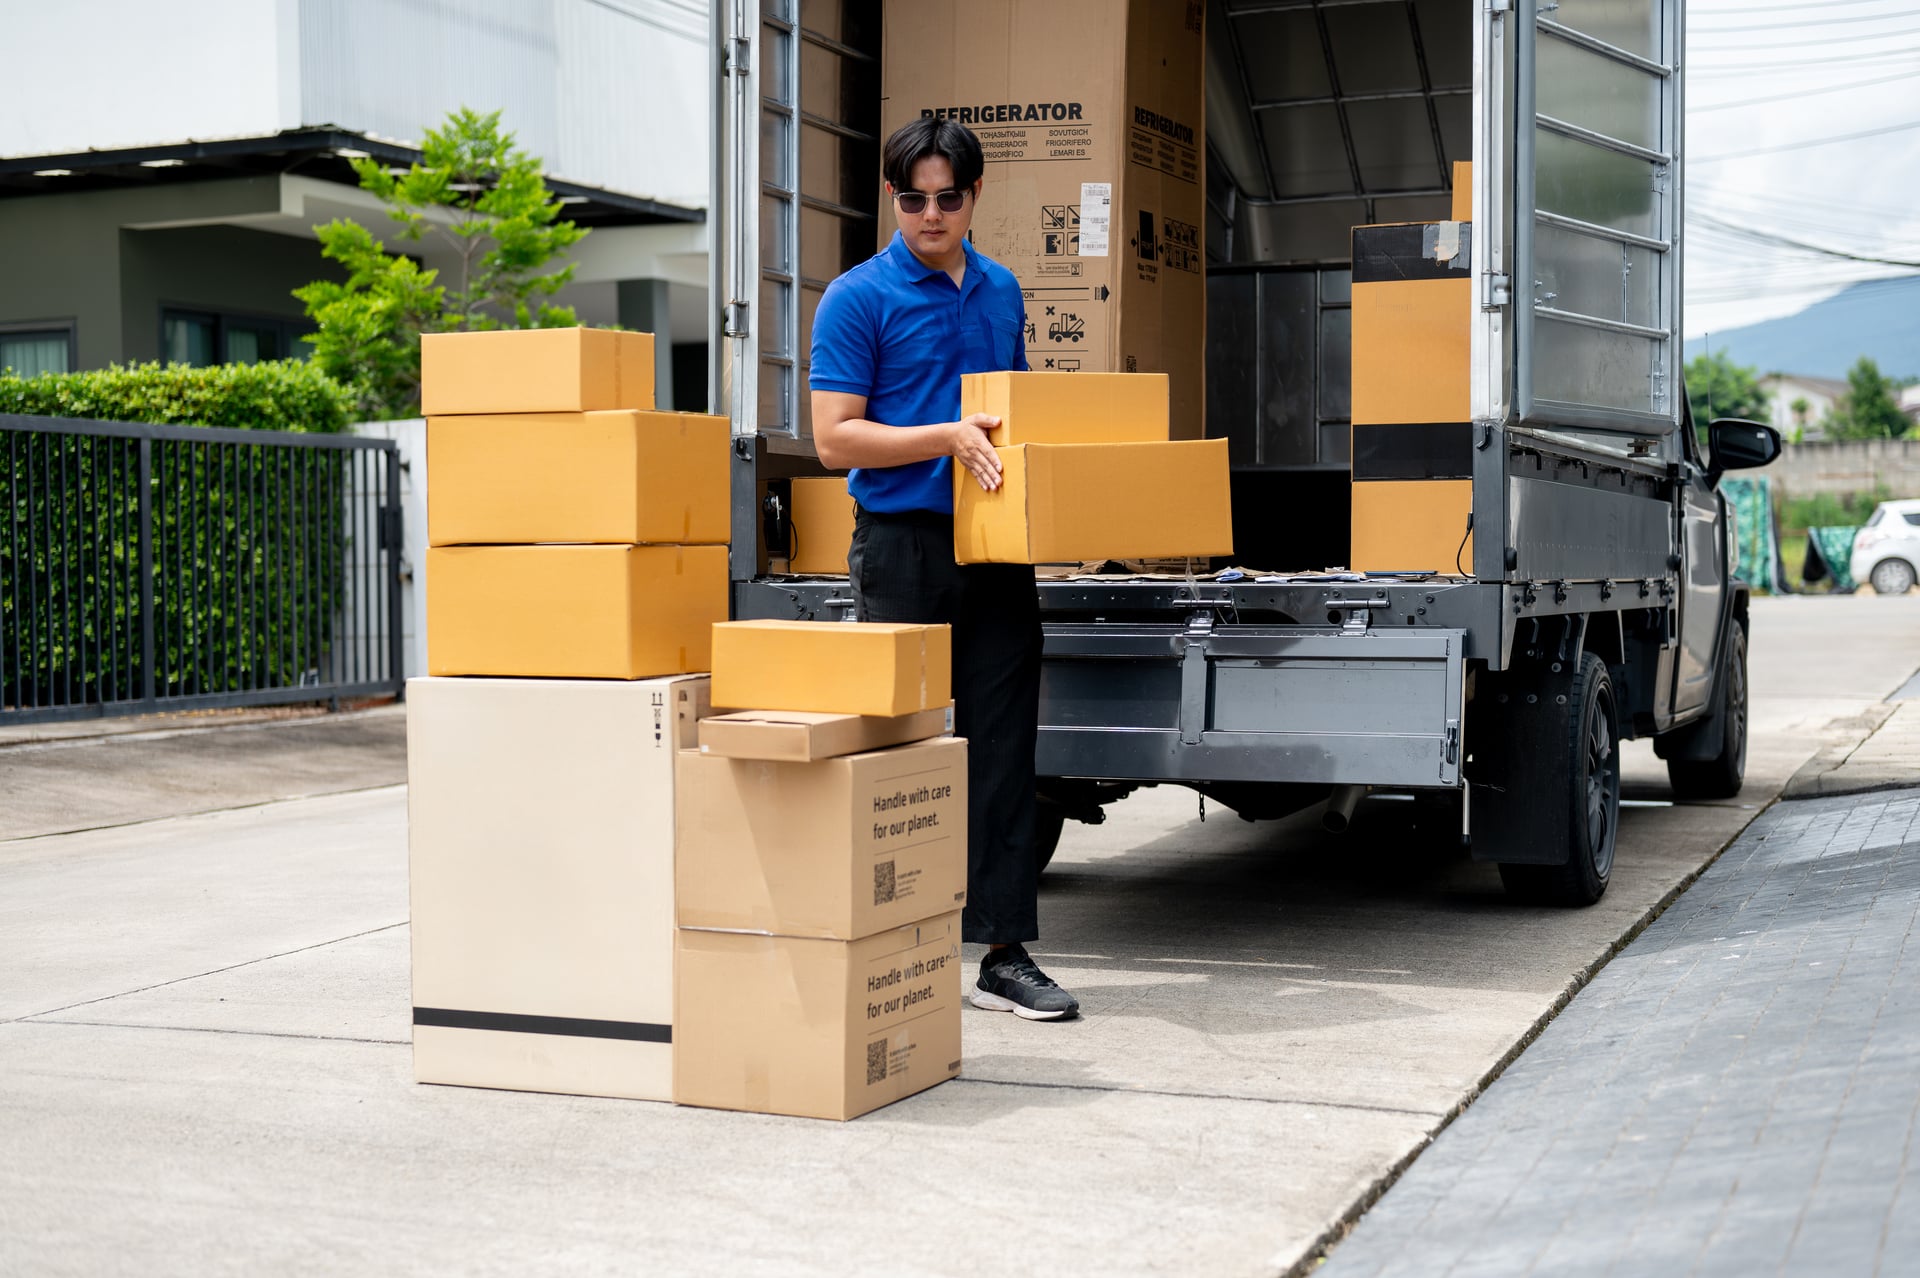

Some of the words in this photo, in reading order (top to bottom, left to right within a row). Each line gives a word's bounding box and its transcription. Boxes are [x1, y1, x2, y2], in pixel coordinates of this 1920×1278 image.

[1049, 129, 1089, 137] SOVUTGICH
[1134, 105, 1195, 146] REFRIGERATOR
[981, 140, 1028, 149] EFRIGERADOR
[1046, 138, 1092, 147] FRIGORIFERO
[873, 790, 907, 813] Handle
[909, 786, 929, 805] with
[931, 784, 951, 800] care
[873, 823, 888, 840] for
[890, 821, 906, 836] our
[908, 811, 940, 837] planet.
[867, 967, 902, 993] Handle
[904, 959, 924, 980] with
[926, 955, 945, 973] care
[867, 1002, 882, 1019] for
[884, 996, 901, 1014] our
[903, 984, 934, 1012] planet.
